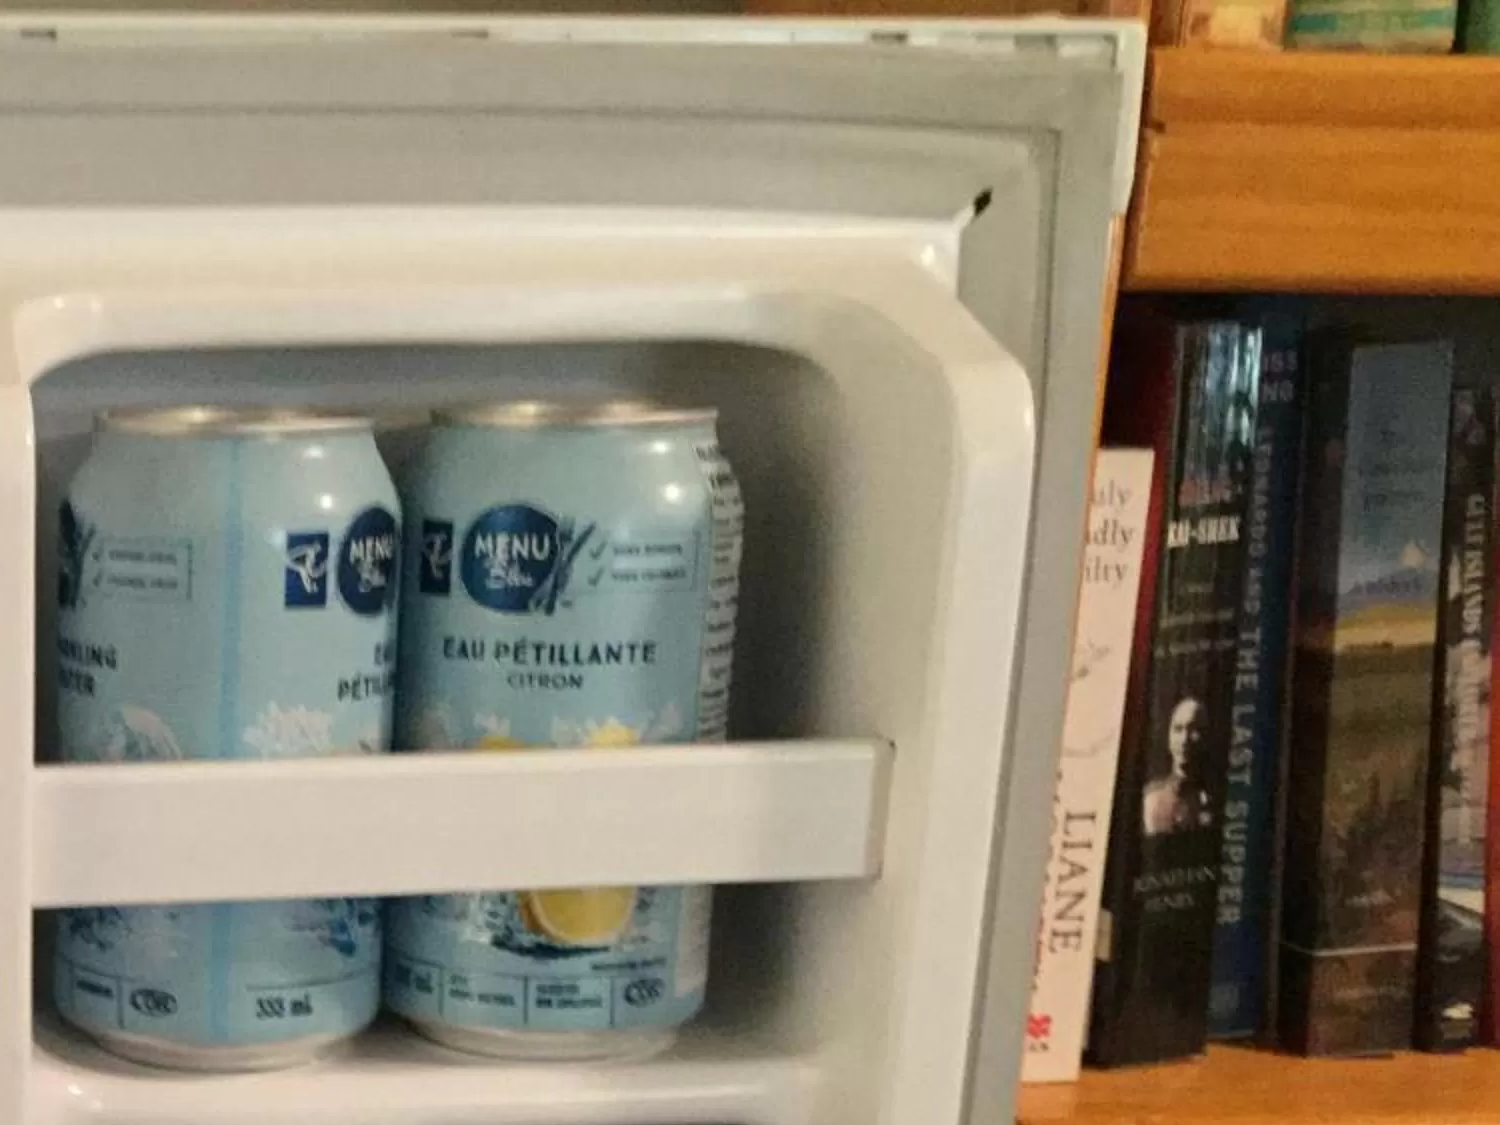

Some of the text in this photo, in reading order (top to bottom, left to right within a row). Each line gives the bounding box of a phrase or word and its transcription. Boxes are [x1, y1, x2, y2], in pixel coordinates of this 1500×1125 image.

[474, 531, 550, 560] MENU
[1092, 517, 1137, 553] dly
[443, 635, 658, 667] EAU PÉTILLANTE
[1235, 624, 1262, 693] THE
[506, 673, 585, 691] CITRON
[1227, 703, 1256, 787] LAST
[1049, 809, 1098, 955] LIANE
[1216, 800, 1250, 927] SUPPER
